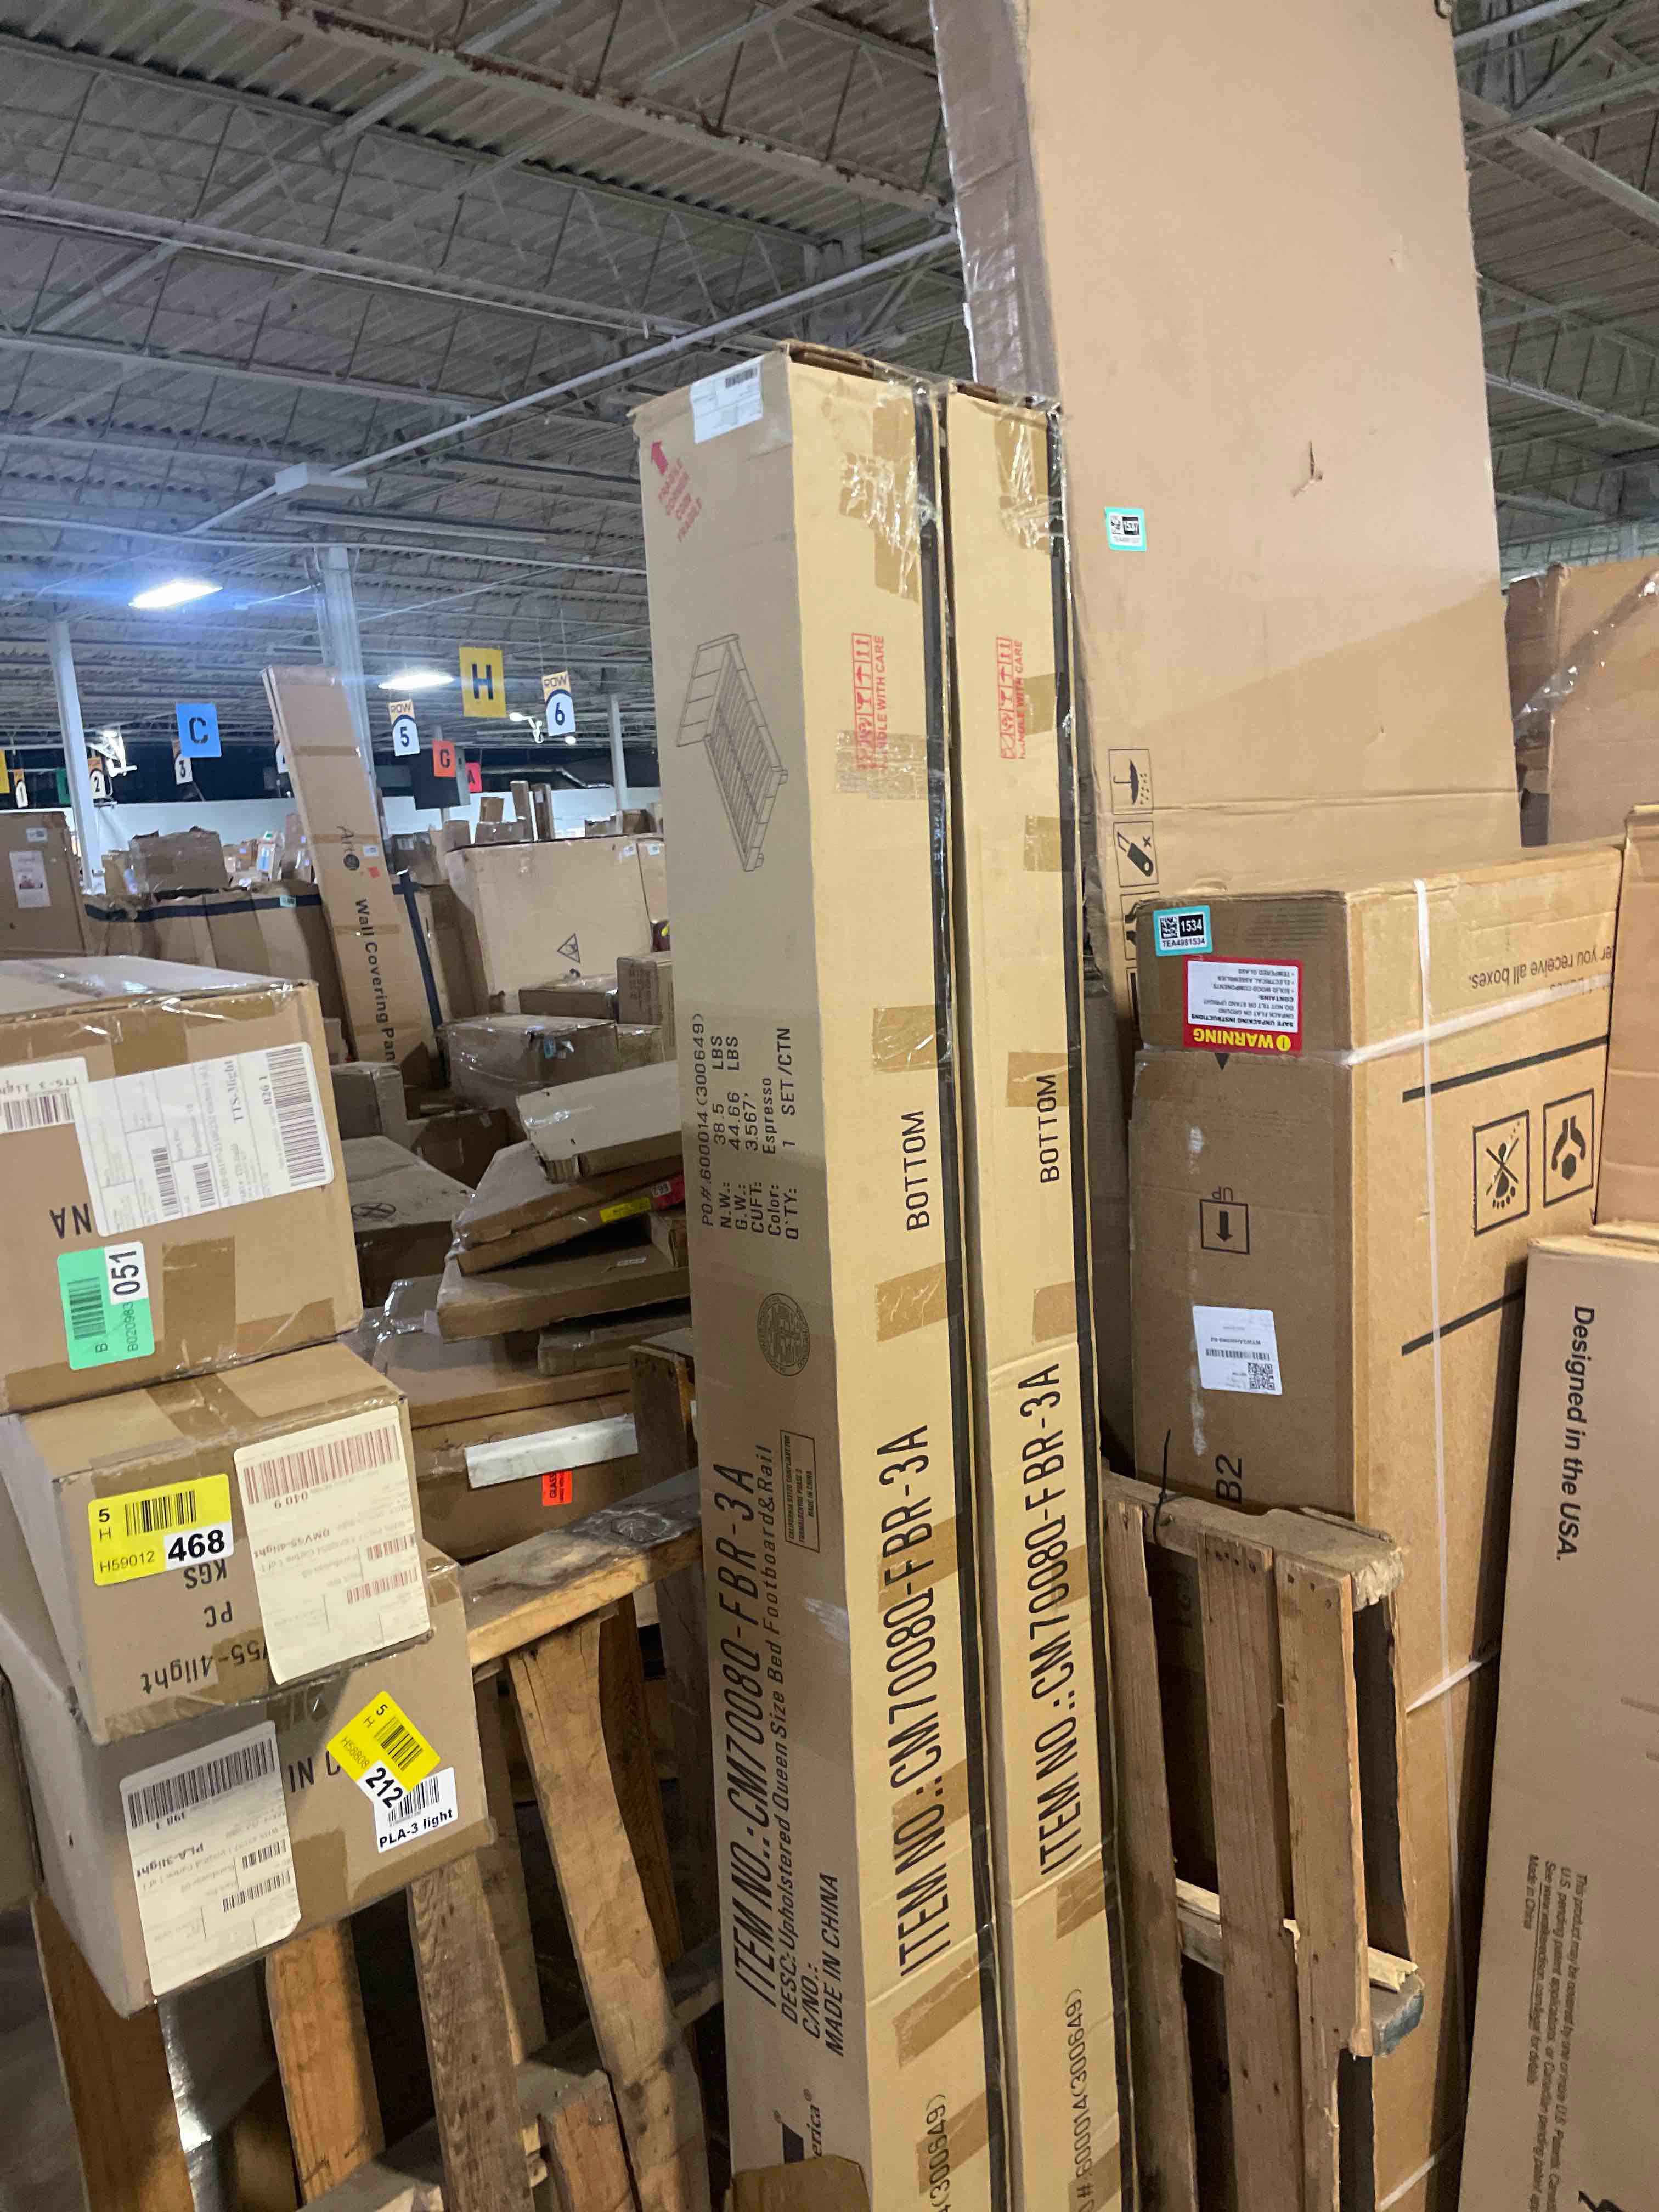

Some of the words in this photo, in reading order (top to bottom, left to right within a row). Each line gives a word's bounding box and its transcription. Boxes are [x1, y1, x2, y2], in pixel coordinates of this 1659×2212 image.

[874, 636, 885, 674] CARE
[1014, 640, 1024, 674] CARE
[472, 664, 494, 701] H
[544, 676, 567, 687] ROW
[876, 675, 887, 710] WITH
[1015, 679, 1025, 708] WITH
[390, 703, 411, 713] ROW
[554, 702, 566, 726] 6
[189, 716, 208, 744] C
[400, 726, 410, 747] 5
[93, 776, 100, 793] 2
[178, 760, 187, 778] 3
[467, 769, 476, 785] A
[356, 898, 374, 937] Wall
[1180, 919, 1203, 933] 1534
[1162, 938, 1206, 947] TEA4981534
[1577, 944, 1597, 962] you
[364, 940, 389, 1024] Covering
[1469, 966, 1509, 989] boxes.
[1514, 963, 1527, 985] all
[1531, 952, 1573, 977] receive
[1191, 1014, 1235, 1023] INSTRUCTIONS
[1237, 1018, 1275, 1026] UNPACKING
[710, 1035, 724, 1070] LBS
[726, 1036, 740, 1071] LBS
[1193, 1028, 1274, 1049] WARNING
[712, 1103, 726, 1146] 38.5
[727, 1091, 741, 1150] 44.66
[762, 1077, 777, 1154] Espresso
[1036, 1073, 1060, 1184] BOTTOM
[901, 1110, 930, 1231] BOTTOM
[719, 1181, 731, 1229] N.W.:
[734, 1184, 747, 1231] G.W.:
[749, 1181, 764, 1234] CUFT:
[767, 1184, 782, 1236] Color:
[1211, 1185, 1234, 1201] UP
[108, 1251, 141, 1296] 051
[95, 1342, 108, 1353] B
[1565, 1304, 1595, 1424] Designed
[1564, 1426, 1587, 1451] in
[1215, 1457, 1243, 1503] B2
[1561, 1456, 1584, 1496] the
[98, 1508, 110, 1523] 5
[1556, 1500, 1581, 1561] USA.
[99, 1527, 111, 1541] H
[168, 1529, 225, 1562] 468
[757, 1444, 780, 1635] Footboard&Rail
[99, 1550, 155, 1573] H59012
[183, 1558, 227, 1589] KGS
[204, 1600, 233, 1628] PC
[766, 1639, 784, 1684] Bed
[363, 1716, 375, 1729] H
[376, 1703, 388, 1716] 5
[769, 1695, 788, 1740] Size
[340, 1736, 370, 1769] H58808
[288, 1757, 315, 1793] IN
[365, 1767, 403, 1809] 212
[772, 1741, 790, 1813] Queen
[379, 1822, 418, 1848] PLA-3
[422, 1808, 453, 1829] light
[1037, 1771, 1082, 1875] ITEM
[819, 1872, 839, 1950] CHINA
[896, 1862, 951, 1977] ITEM
[732, 1895, 776, 2008] ITEM
[823, 1949, 842, 1982] IN
[800, 1962, 821, 2039] C/NO.:
[824, 1983, 844, 2057] MADE
[803, 2103, 822, 2160] erica
